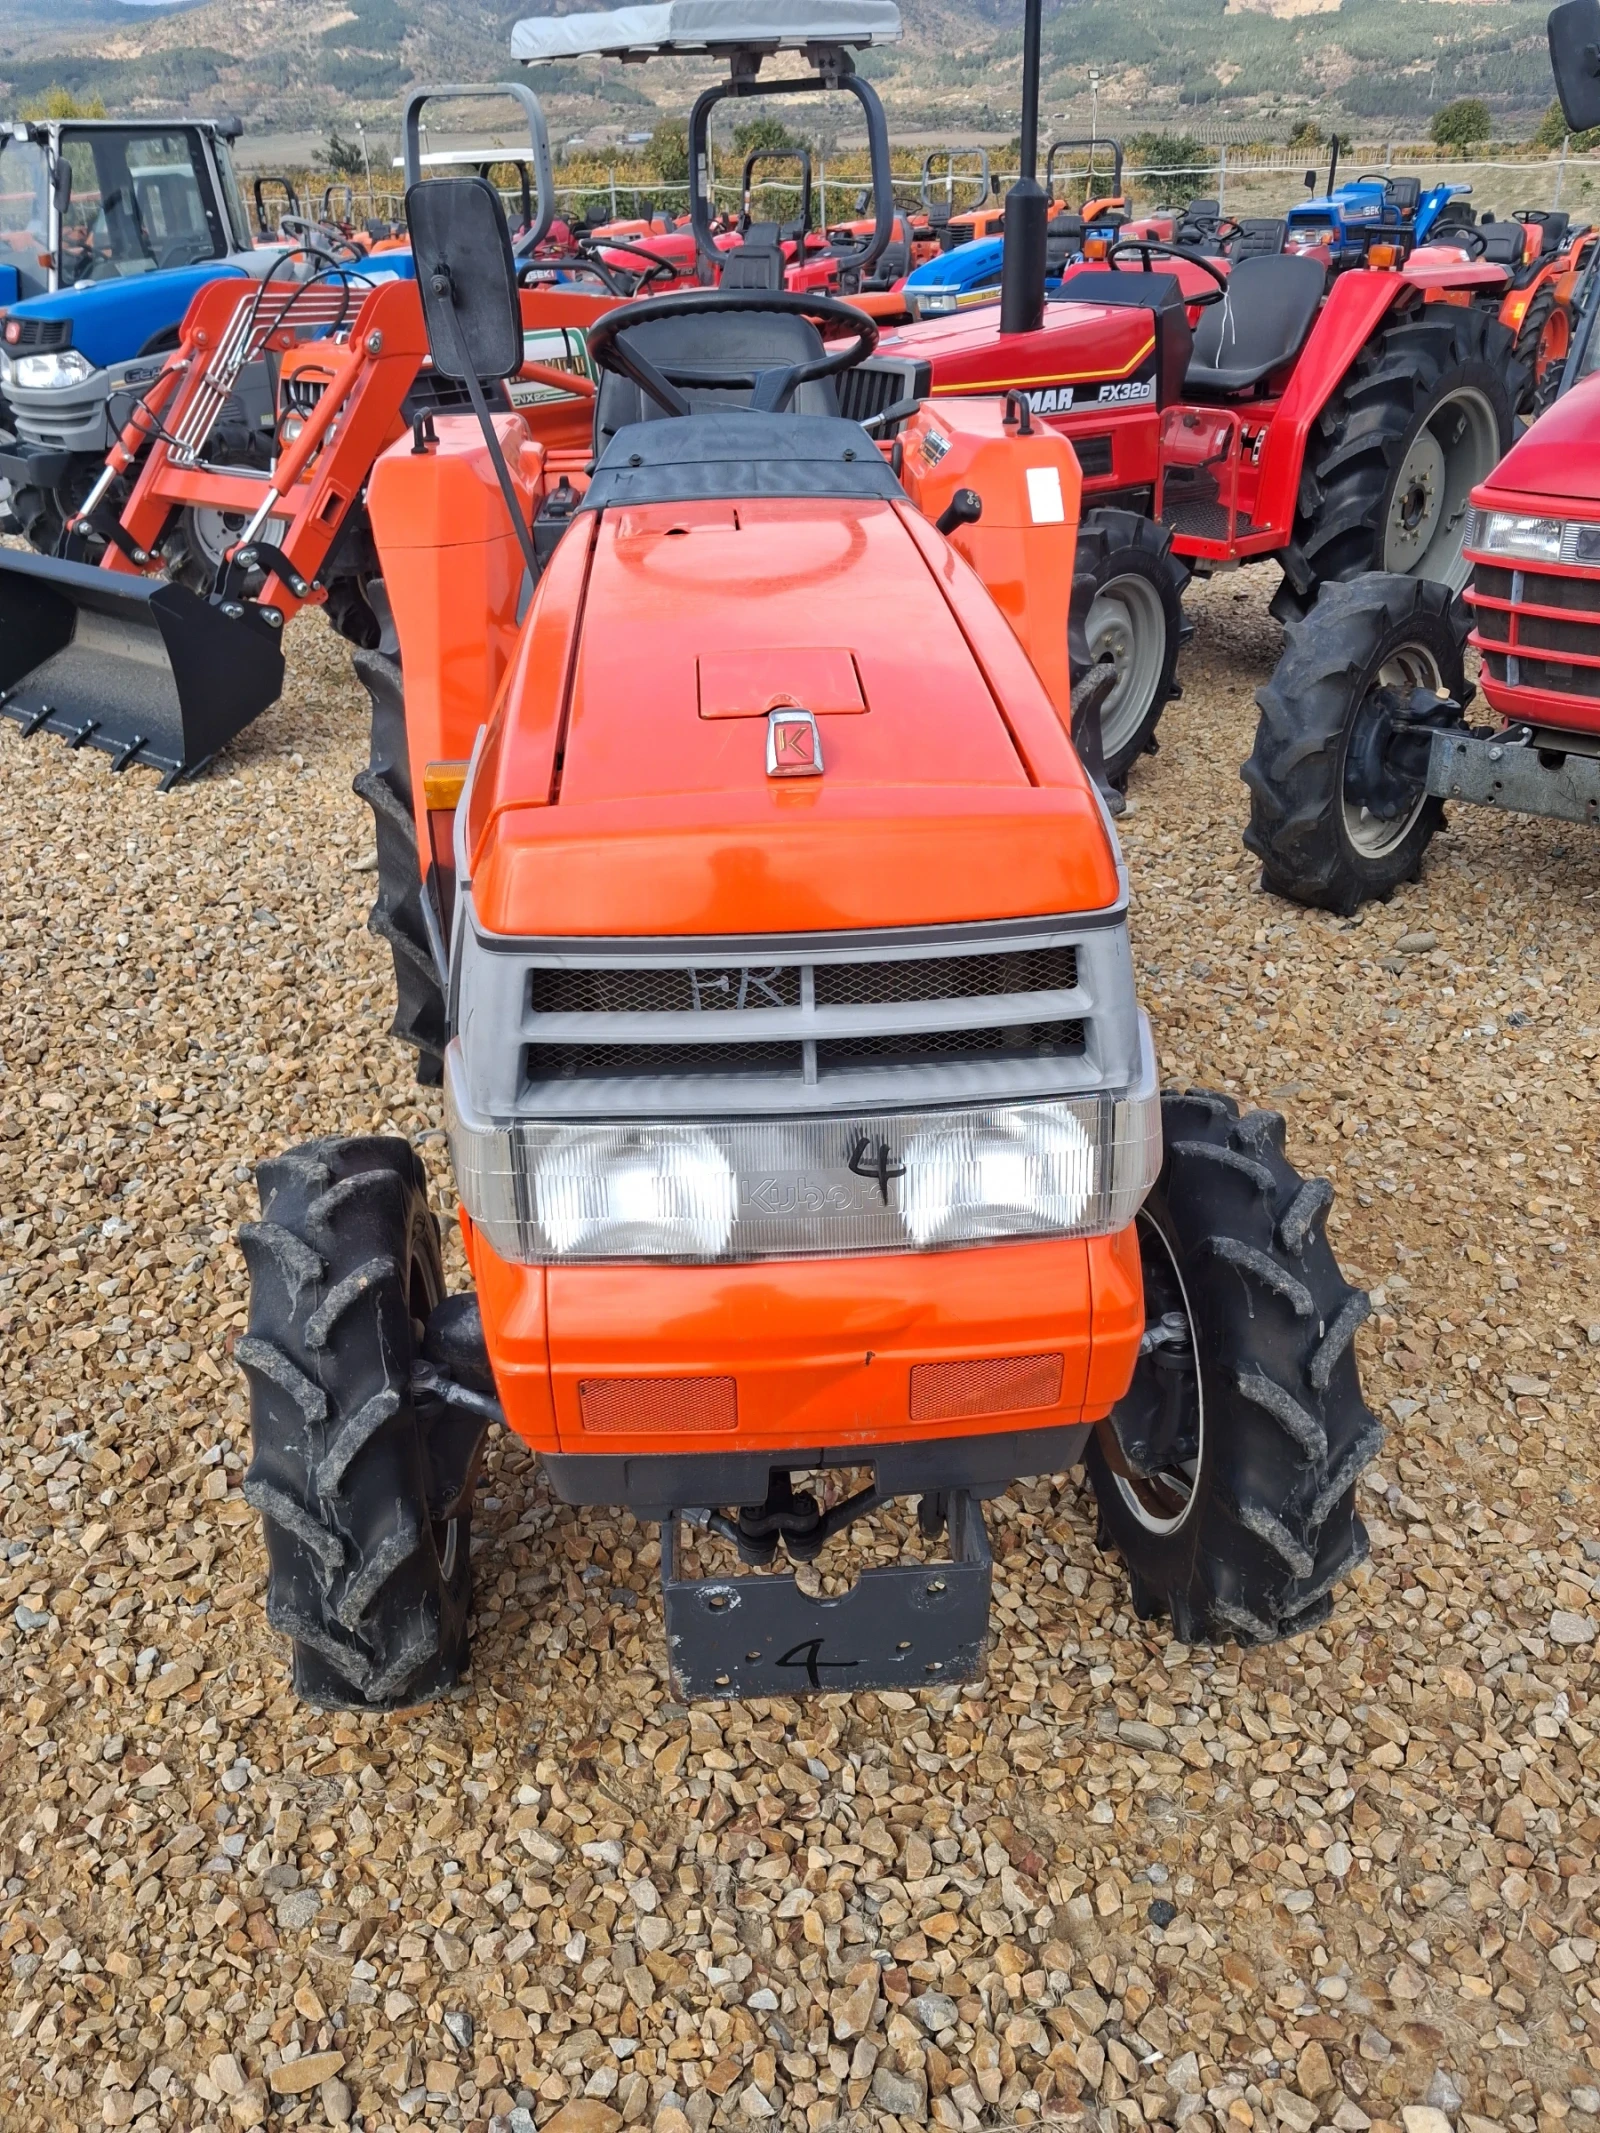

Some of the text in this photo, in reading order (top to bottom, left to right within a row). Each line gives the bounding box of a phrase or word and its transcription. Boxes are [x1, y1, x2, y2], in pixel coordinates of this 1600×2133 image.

[778, 727, 809, 759] K
[848, 1137, 907, 1207] 4
[741, 1176, 896, 1214] Kubota
[775, 1637, 859, 1690] 4
